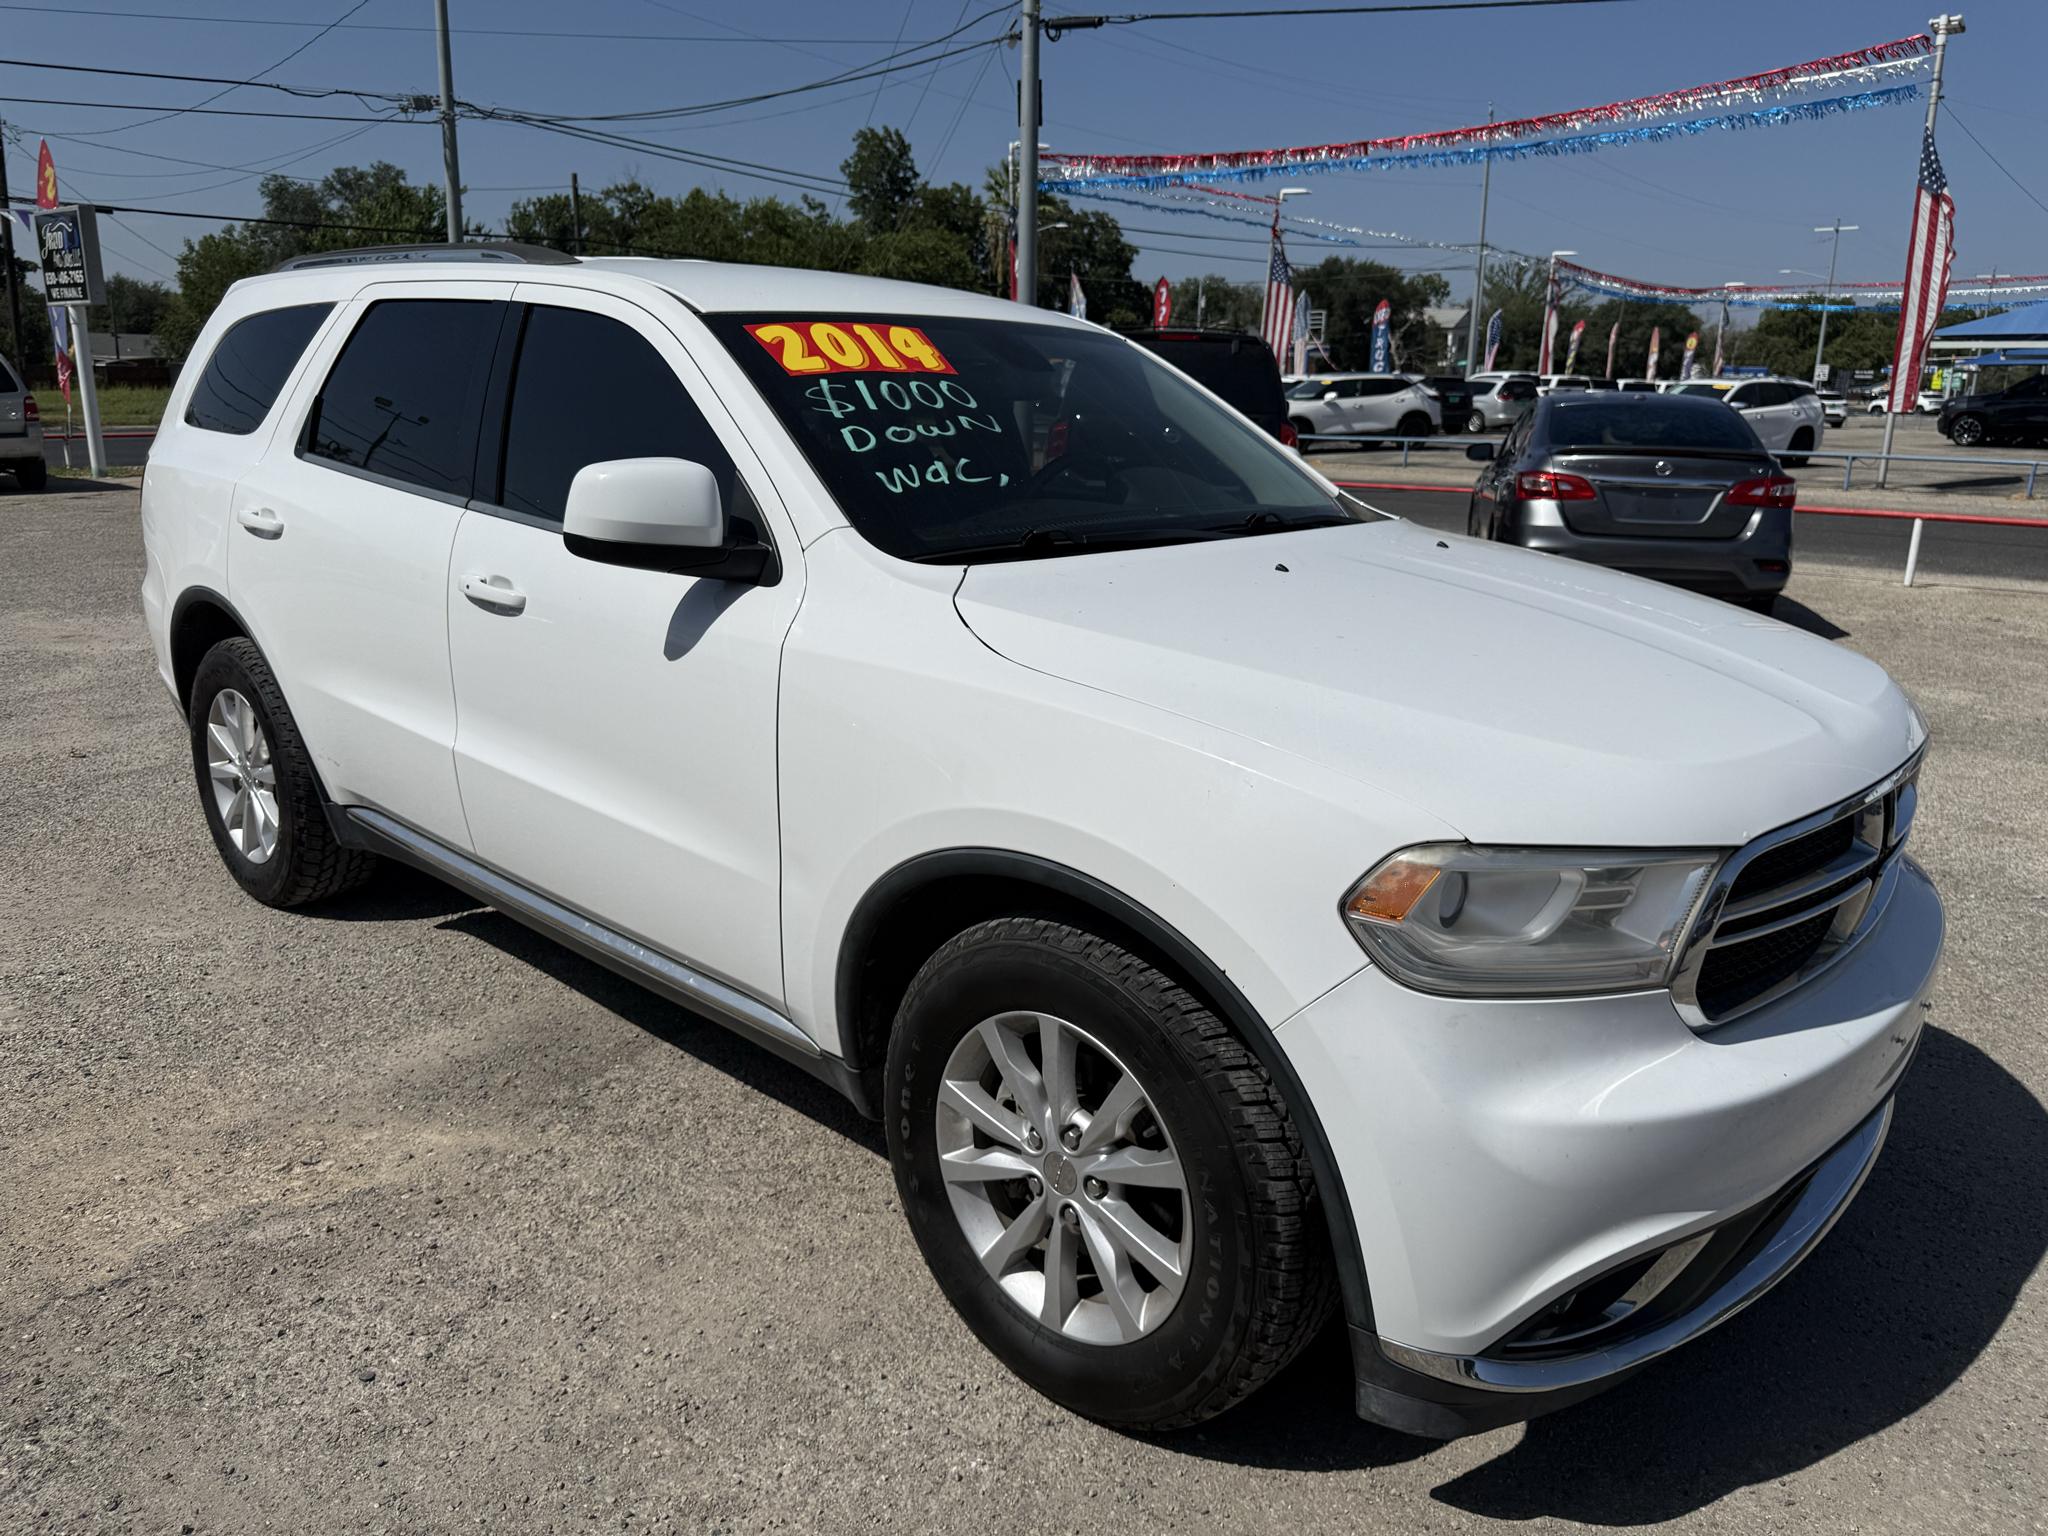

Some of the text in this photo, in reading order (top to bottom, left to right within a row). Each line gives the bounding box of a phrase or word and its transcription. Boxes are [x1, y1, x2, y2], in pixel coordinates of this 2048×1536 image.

[755, 322, 945, 371] 2014
[1373, 325, 1385, 372] TRUC
[805, 378, 978, 418] $1000
